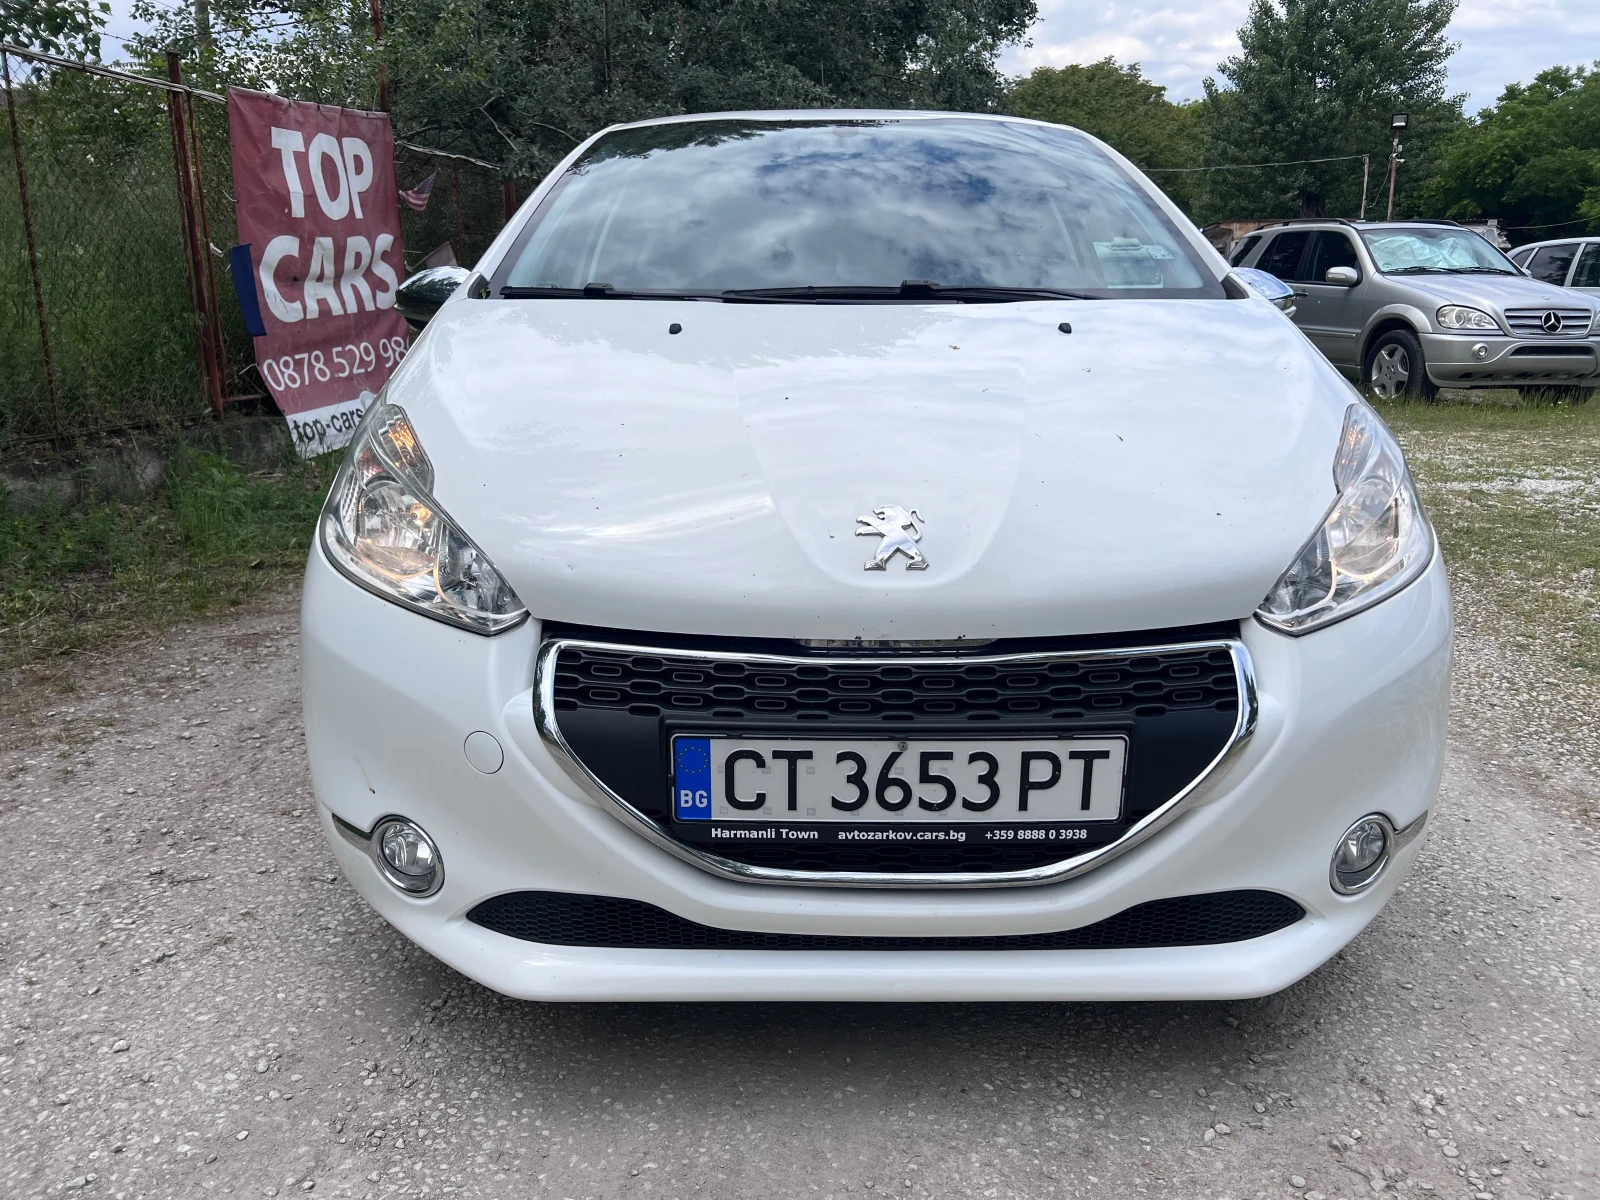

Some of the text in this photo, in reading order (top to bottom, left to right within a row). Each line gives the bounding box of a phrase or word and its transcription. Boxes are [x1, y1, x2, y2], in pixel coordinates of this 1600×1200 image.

[271, 126, 373, 221] TOP
[259, 233, 399, 323] CARS
[263, 335, 409, 391] 0878 529 98
[680, 790, 708, 808] BG
[724, 749, 1110, 812] CT 3653 PT
[711, 827, 1087, 842] Harmanli Town avtozarkov.cars.bg +359 8888 0 3938
